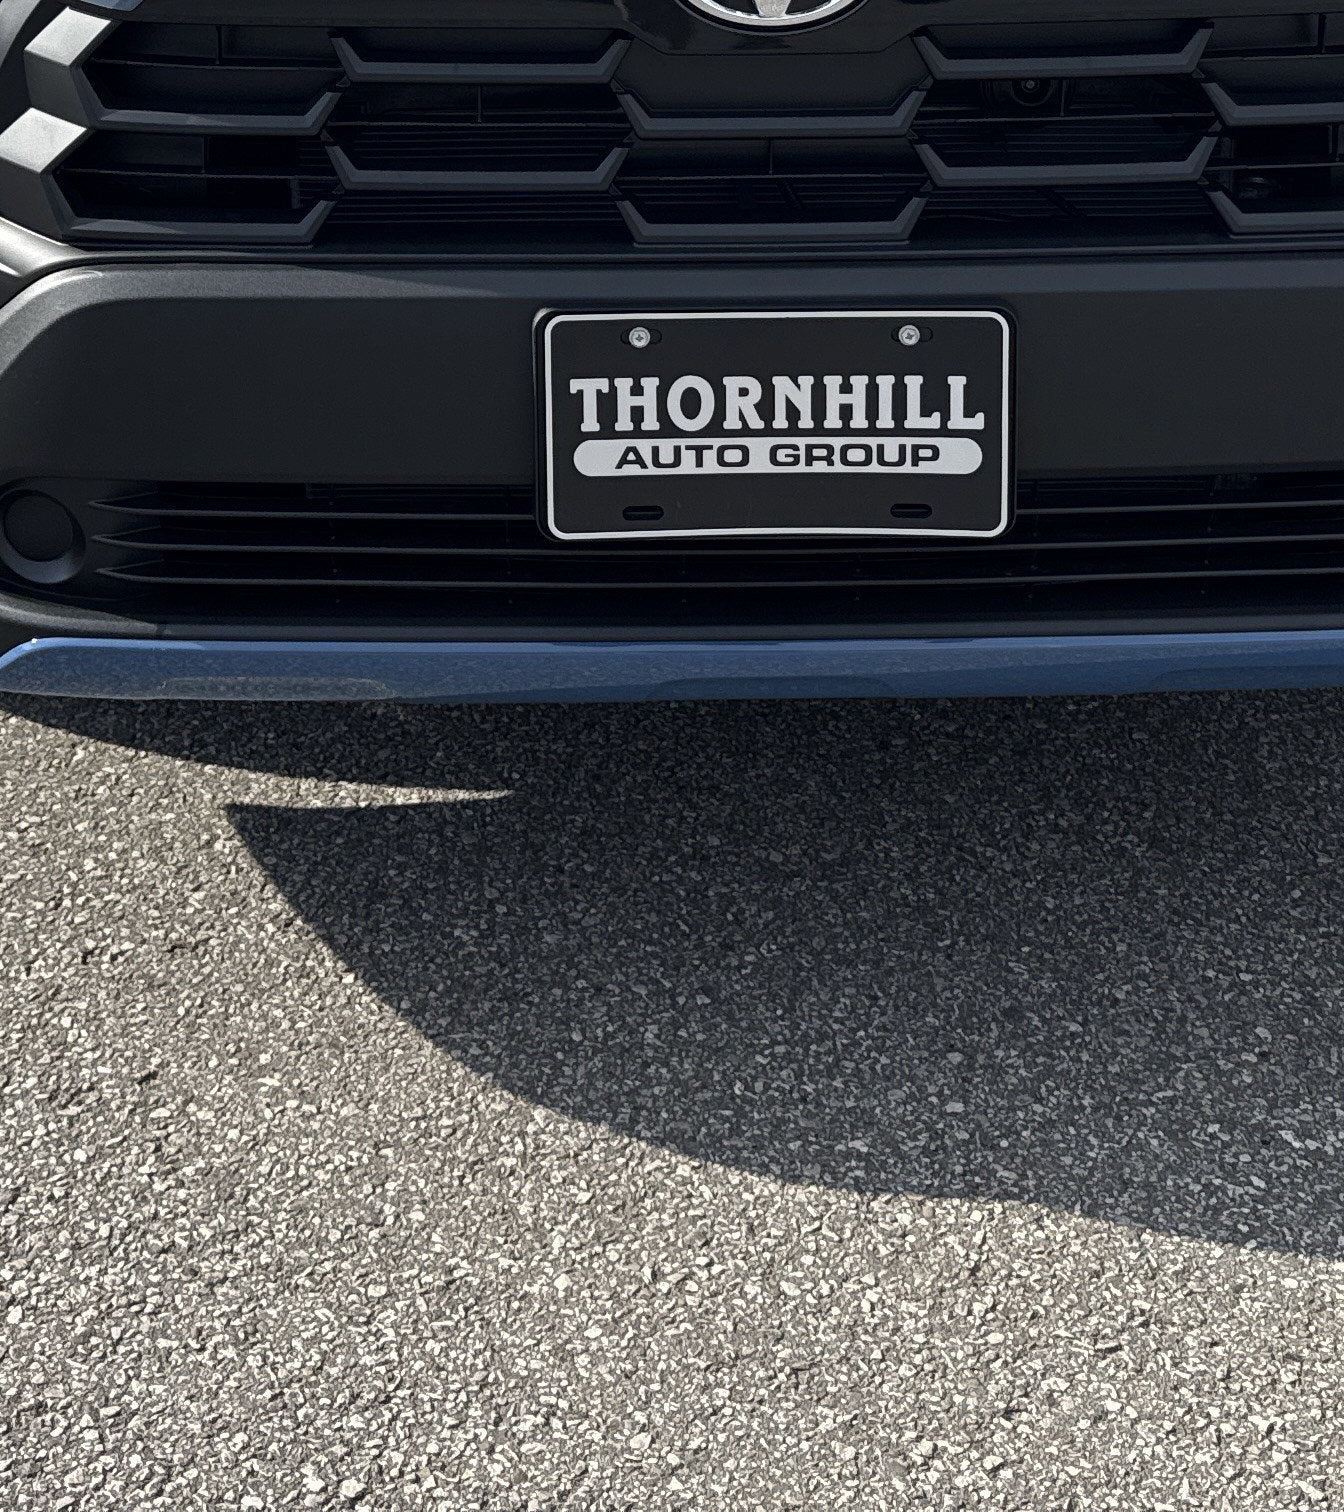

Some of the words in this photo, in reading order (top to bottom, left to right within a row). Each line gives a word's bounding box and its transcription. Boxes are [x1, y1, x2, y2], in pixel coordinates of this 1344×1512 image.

[569, 374, 985, 432] THORNHILL
[614, 444, 750, 470] AUTO
[769, 443, 940, 467] GROUP
